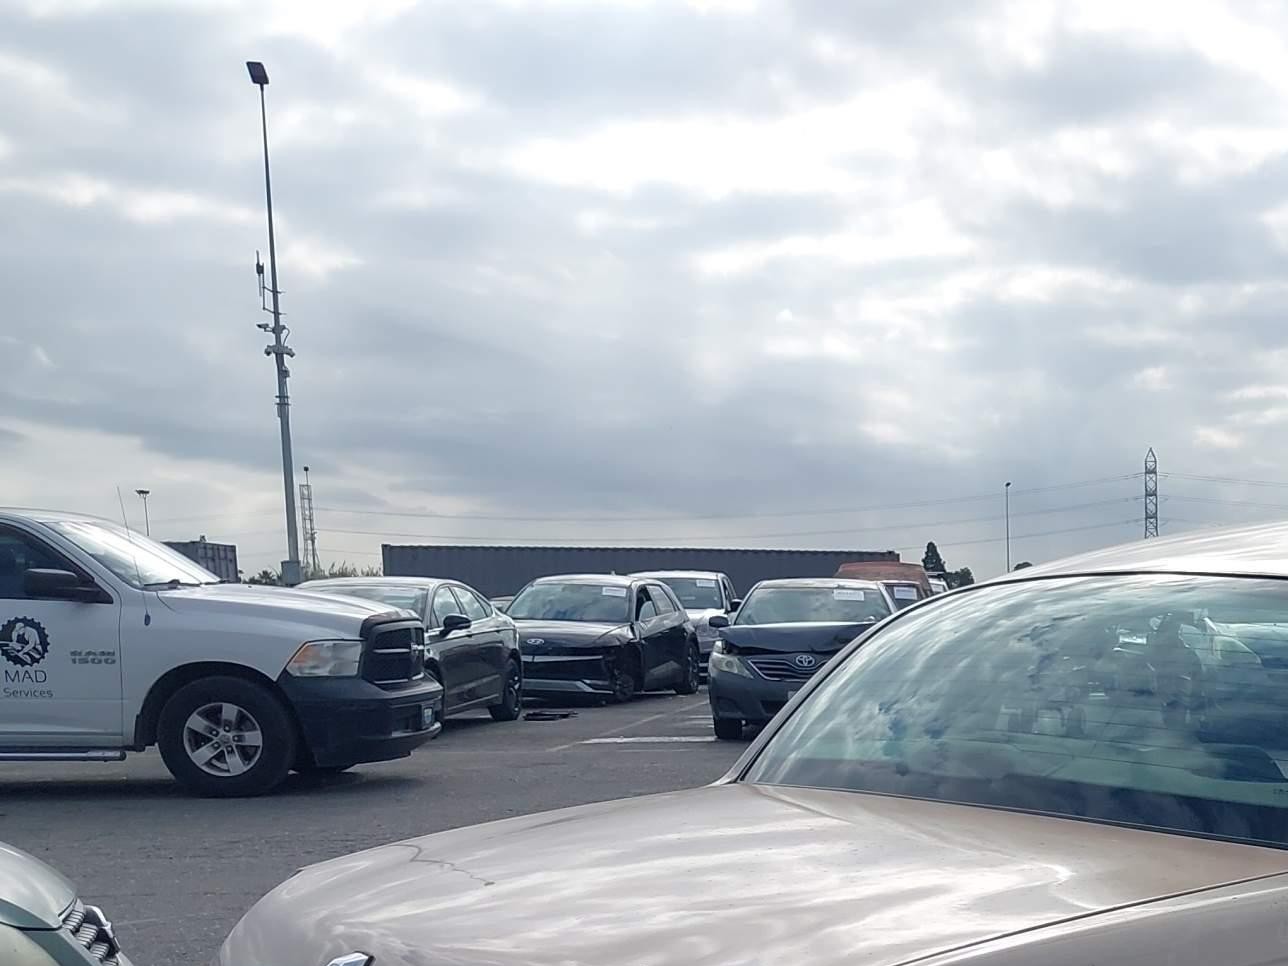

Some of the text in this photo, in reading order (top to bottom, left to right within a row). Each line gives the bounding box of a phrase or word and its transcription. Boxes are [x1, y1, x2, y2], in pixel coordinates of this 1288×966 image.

[71, 657, 117, 665] 1500
[4, 669, 48, 684] MAD
[2, 687, 54, 699] Services
